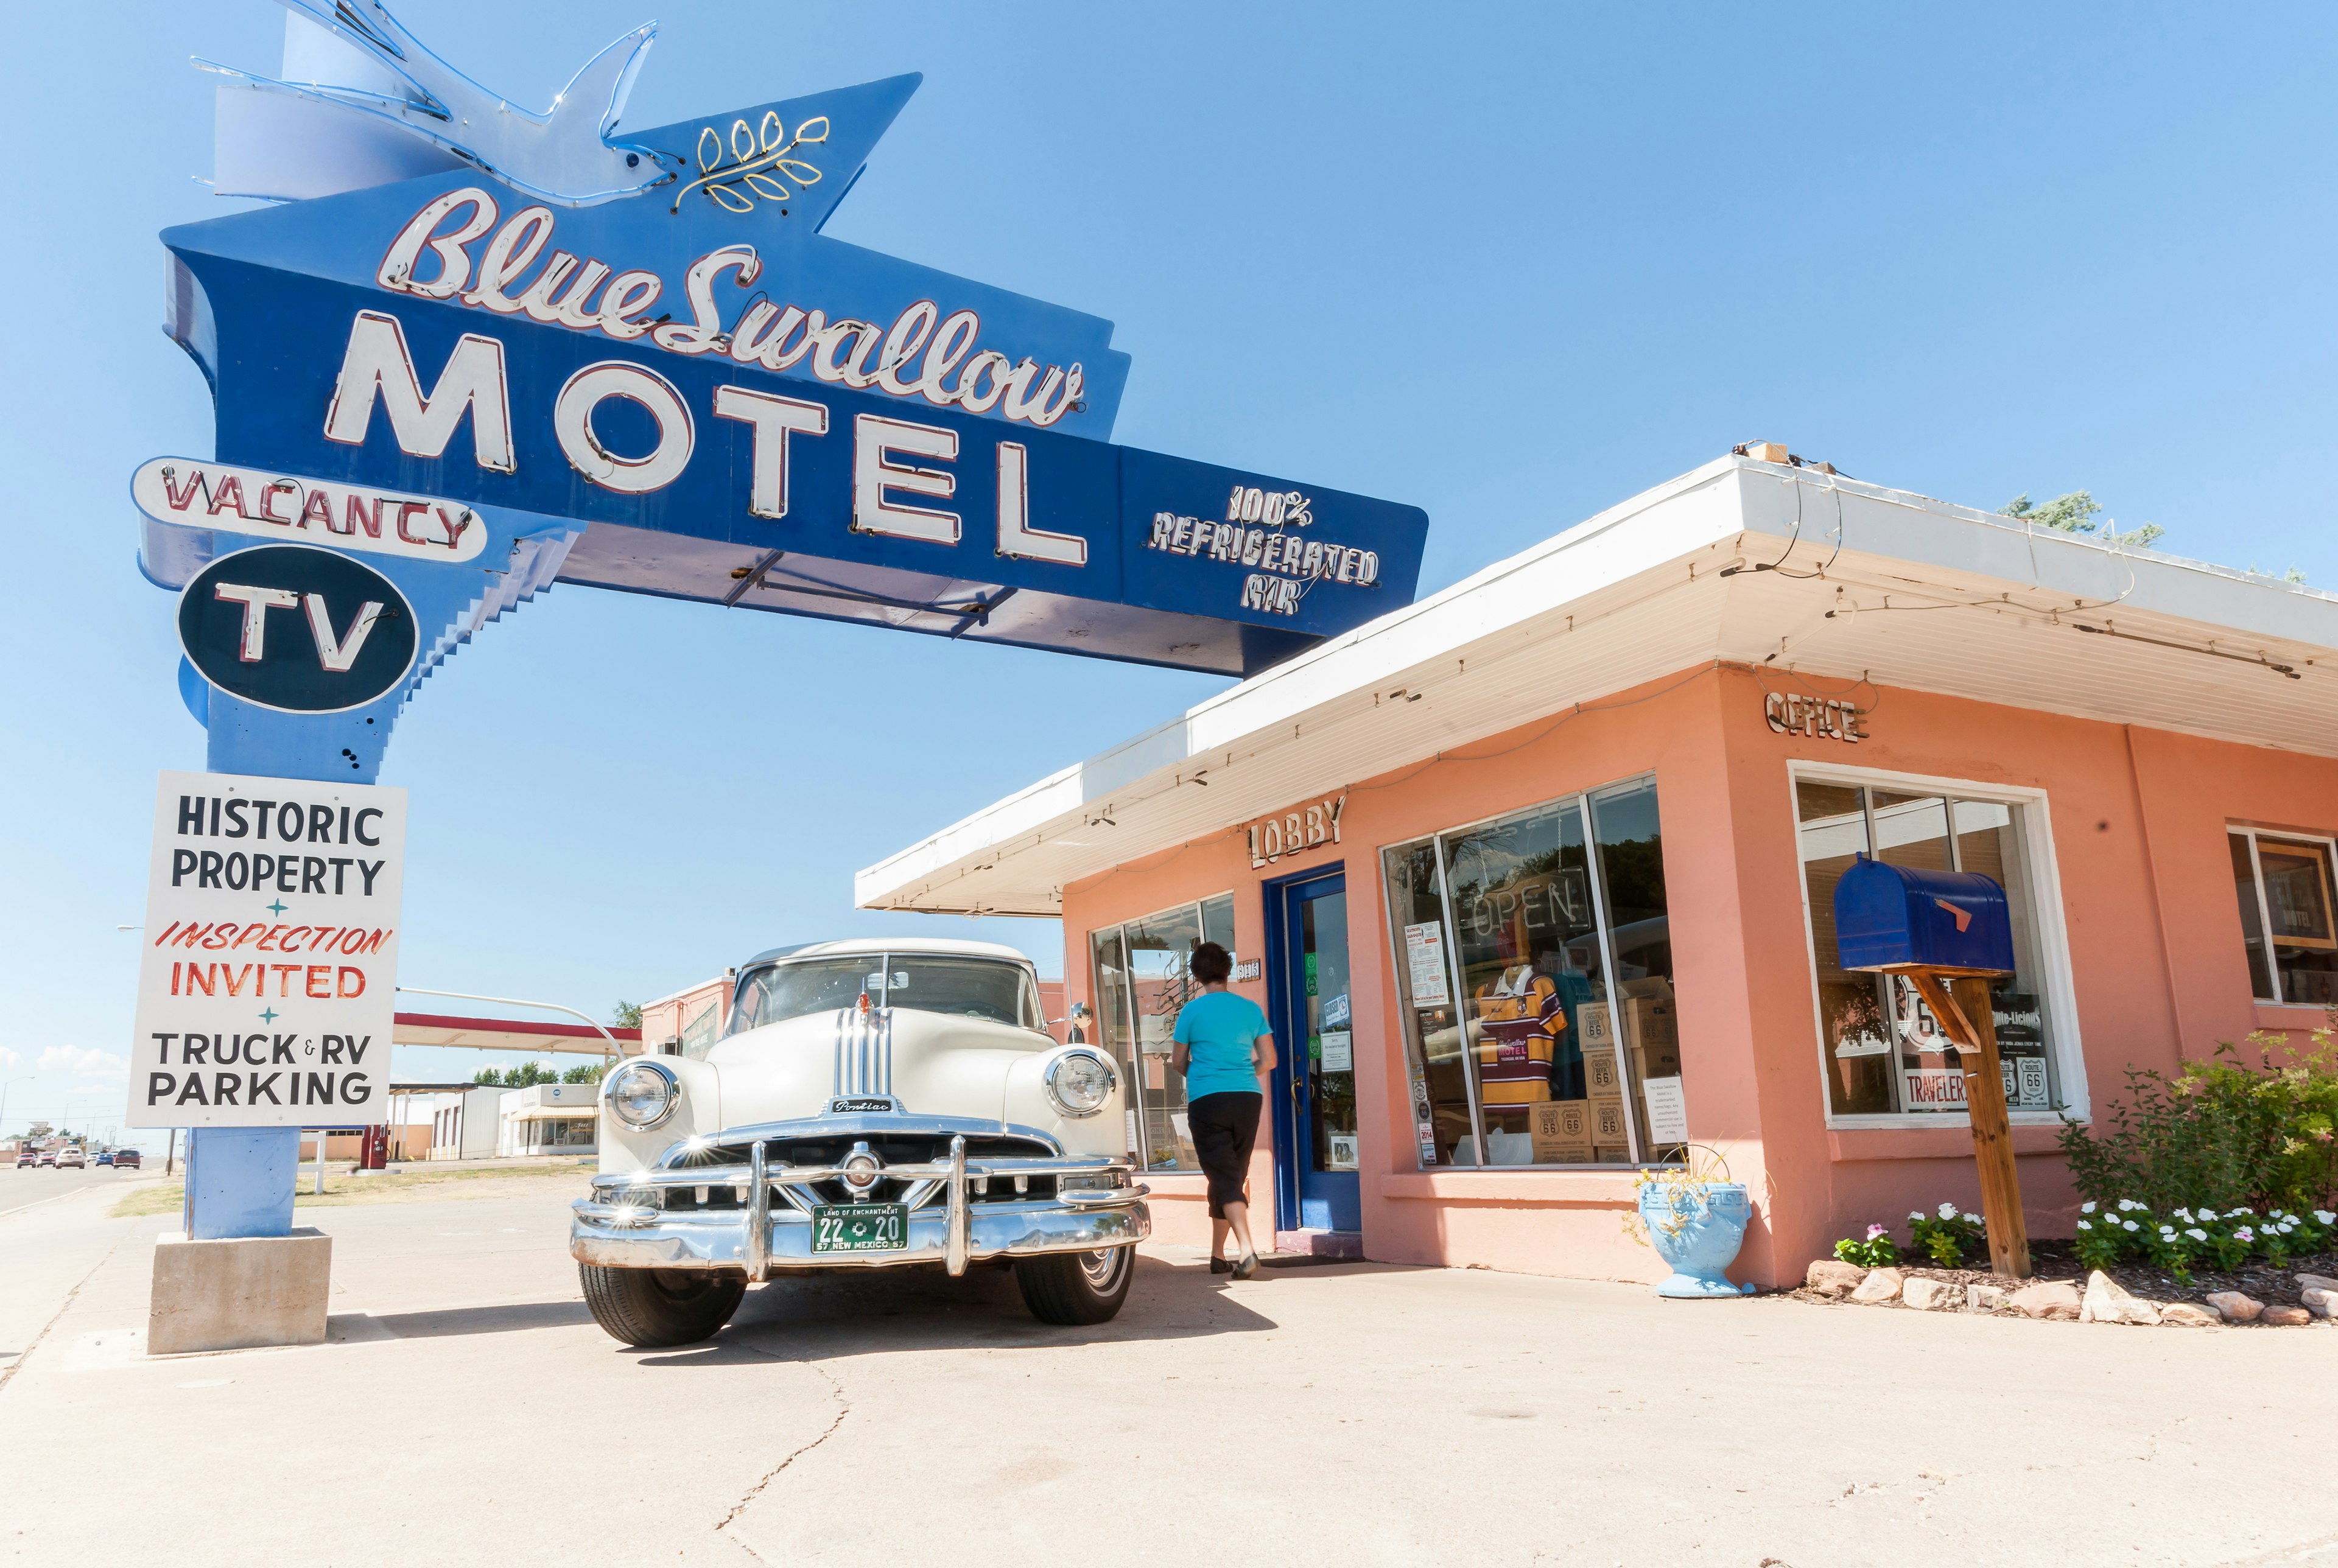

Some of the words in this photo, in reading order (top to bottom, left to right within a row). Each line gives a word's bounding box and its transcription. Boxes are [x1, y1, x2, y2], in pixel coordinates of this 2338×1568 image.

[376, 187, 667, 340] Blue
[651, 244, 1085, 427] Swallow
[323, 309, 1088, 566] MOTEL
[162, 464, 471, 549] VACANCY
[1226, 486, 1313, 527] 100%
[1150, 513, 1378, 587] REFRIGERATED
[1241, 574, 1302, 615] AIR
[215, 583, 384, 672] TV
[1764, 692, 1867, 744] OFFICE
[177, 796, 384, 846] HISTORIC
[1250, 796, 1346, 870] LOBBY
[172, 849, 386, 896] PROPERTY
[1473, 878, 1576, 936] OPEN
[155, 921, 393, 954] INSPECTION
[171, 962, 367, 998] INVITED
[1238, 964, 1257, 976] 815
[1325, 1000, 1338, 1016] CLOSED
[1589, 1025, 1601, 1035] 66
[152, 1033, 298, 1065] TRUCK
[304, 1039, 316, 1056] &
[321, 1035, 371, 1065] RV
[1498, 1046, 1526, 1055] MOTEL
[147, 1073, 371, 1105] PARKING
[1596, 1073, 1609, 1083] 66
[2027, 1074, 2040, 1087] 66
[836, 1101, 888, 1111] Pontiac
[1543, 1124, 1556, 1133] 66
[1567, 1120, 1579, 1129] 66
[1603, 1122, 1615, 1132] 66
[820, 1218, 843, 1243] 22
[876, 1216, 899, 1241] 20
